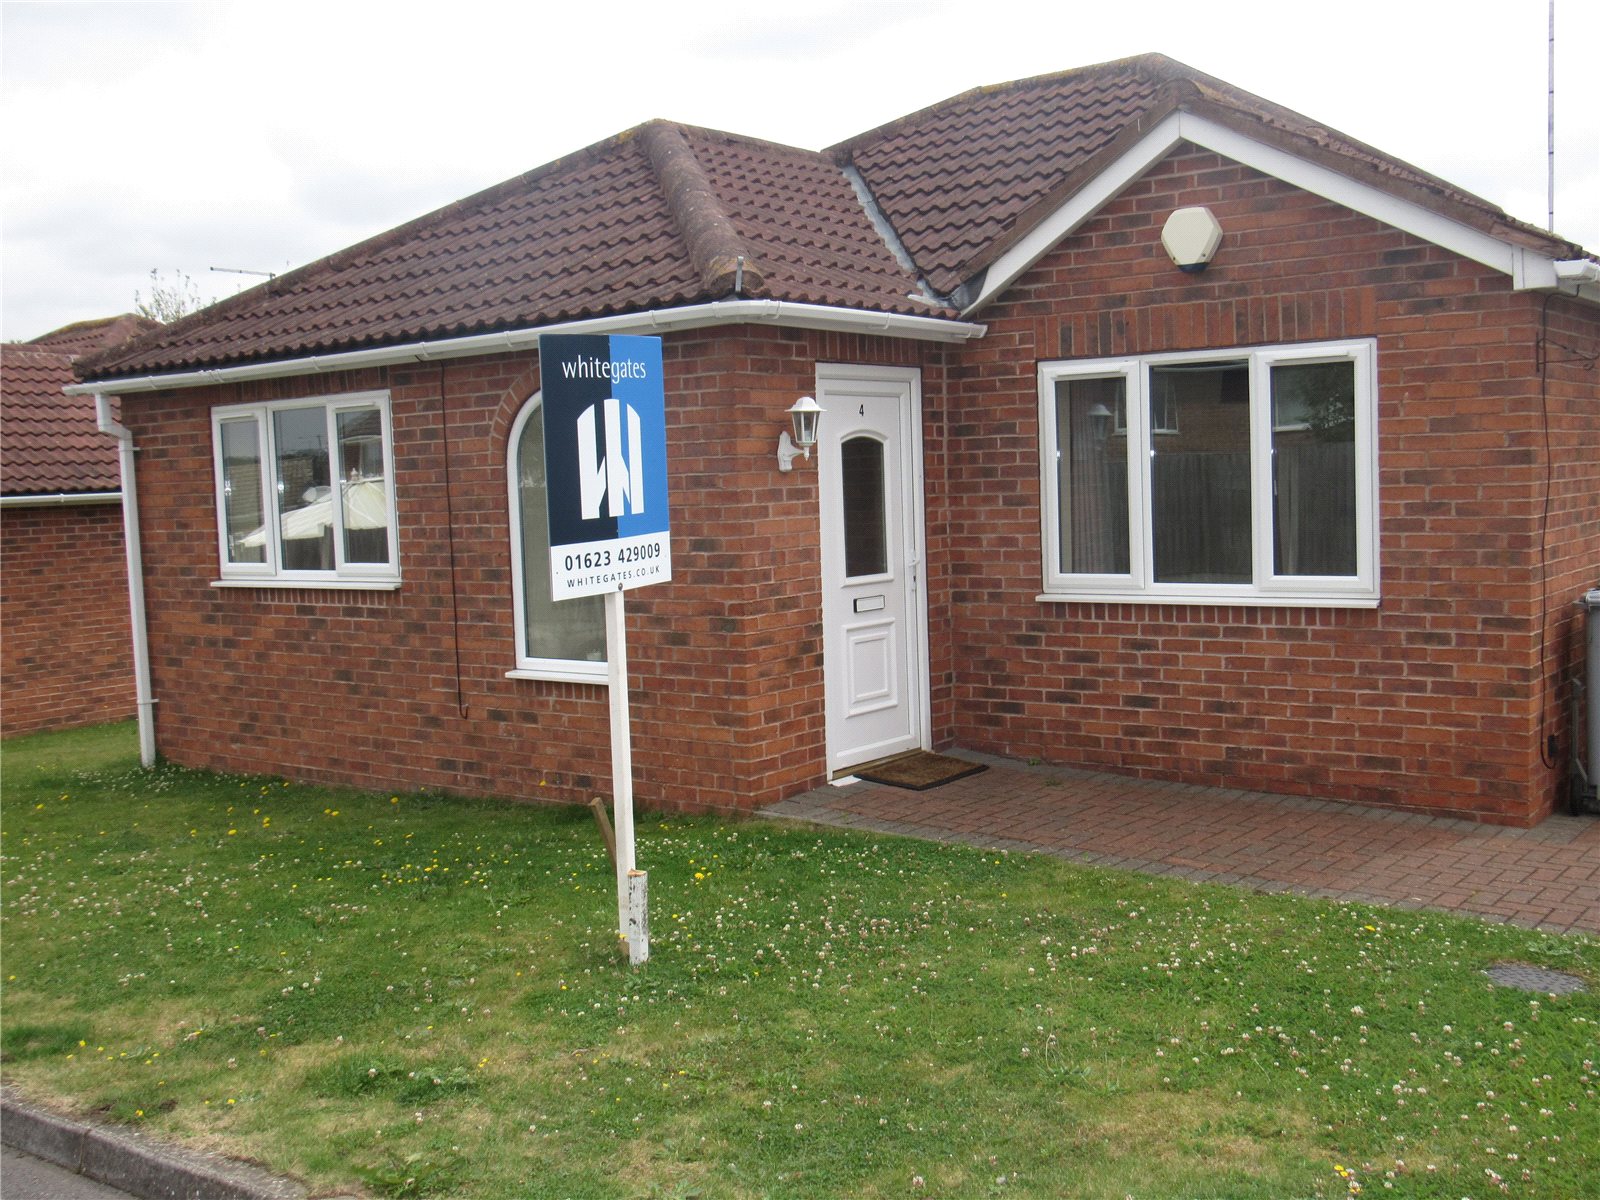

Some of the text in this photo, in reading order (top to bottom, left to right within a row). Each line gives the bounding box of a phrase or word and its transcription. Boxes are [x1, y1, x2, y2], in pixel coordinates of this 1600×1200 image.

[562, 355, 647, 384] whitegates
[858, 404, 865, 417] 4
[564, 542, 661, 572] 01623 429009
[566, 565, 660, 588] WHITEGATES.CO.UK
